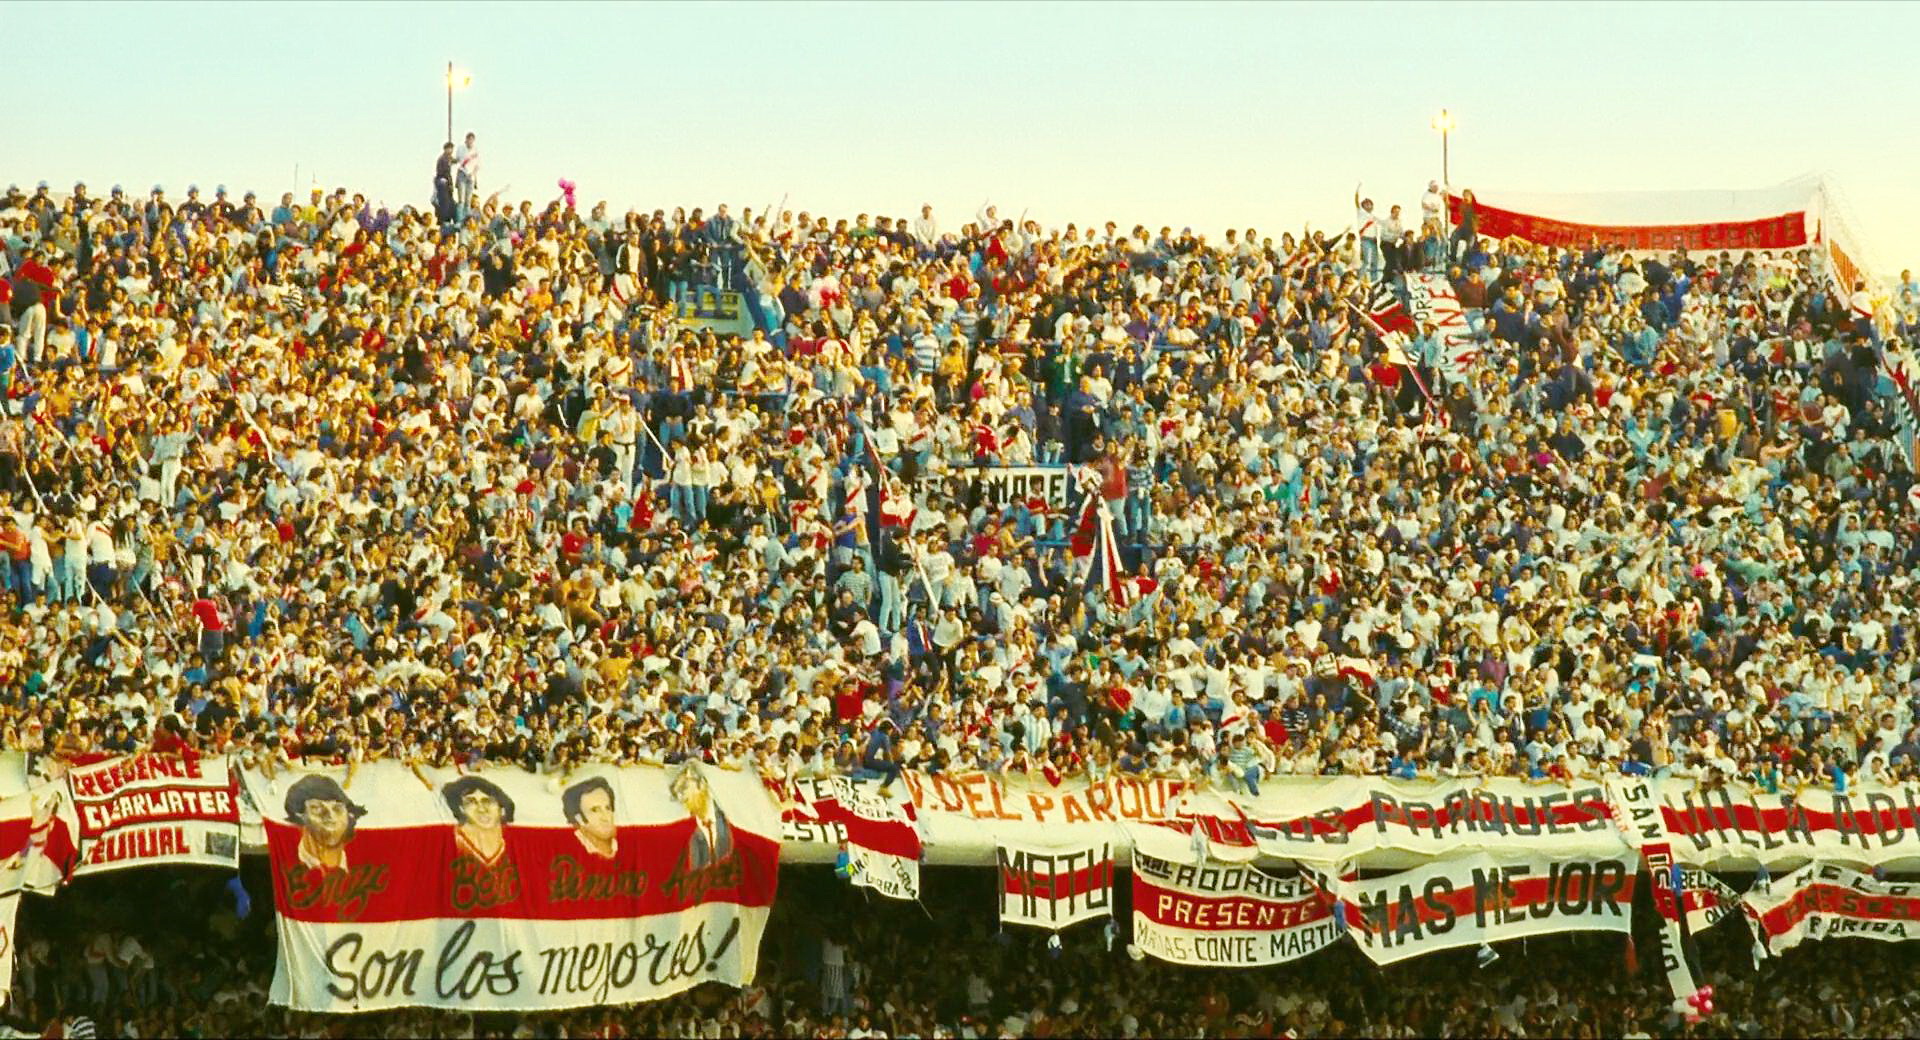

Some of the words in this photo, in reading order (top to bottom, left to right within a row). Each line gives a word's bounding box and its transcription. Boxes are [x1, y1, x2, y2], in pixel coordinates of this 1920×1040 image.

[84, 791, 231, 829] CLEARWATER
[1623, 784, 1662, 838] SAN
[1664, 787, 1816, 851] VILLA
[1158, 895, 1316, 925] PRESENTE
[1358, 876, 1457, 948] MAS
[1472, 859, 1627, 928] MEJOR
[326, 933, 424, 1002] Son
[435, 920, 522, 1000] los
